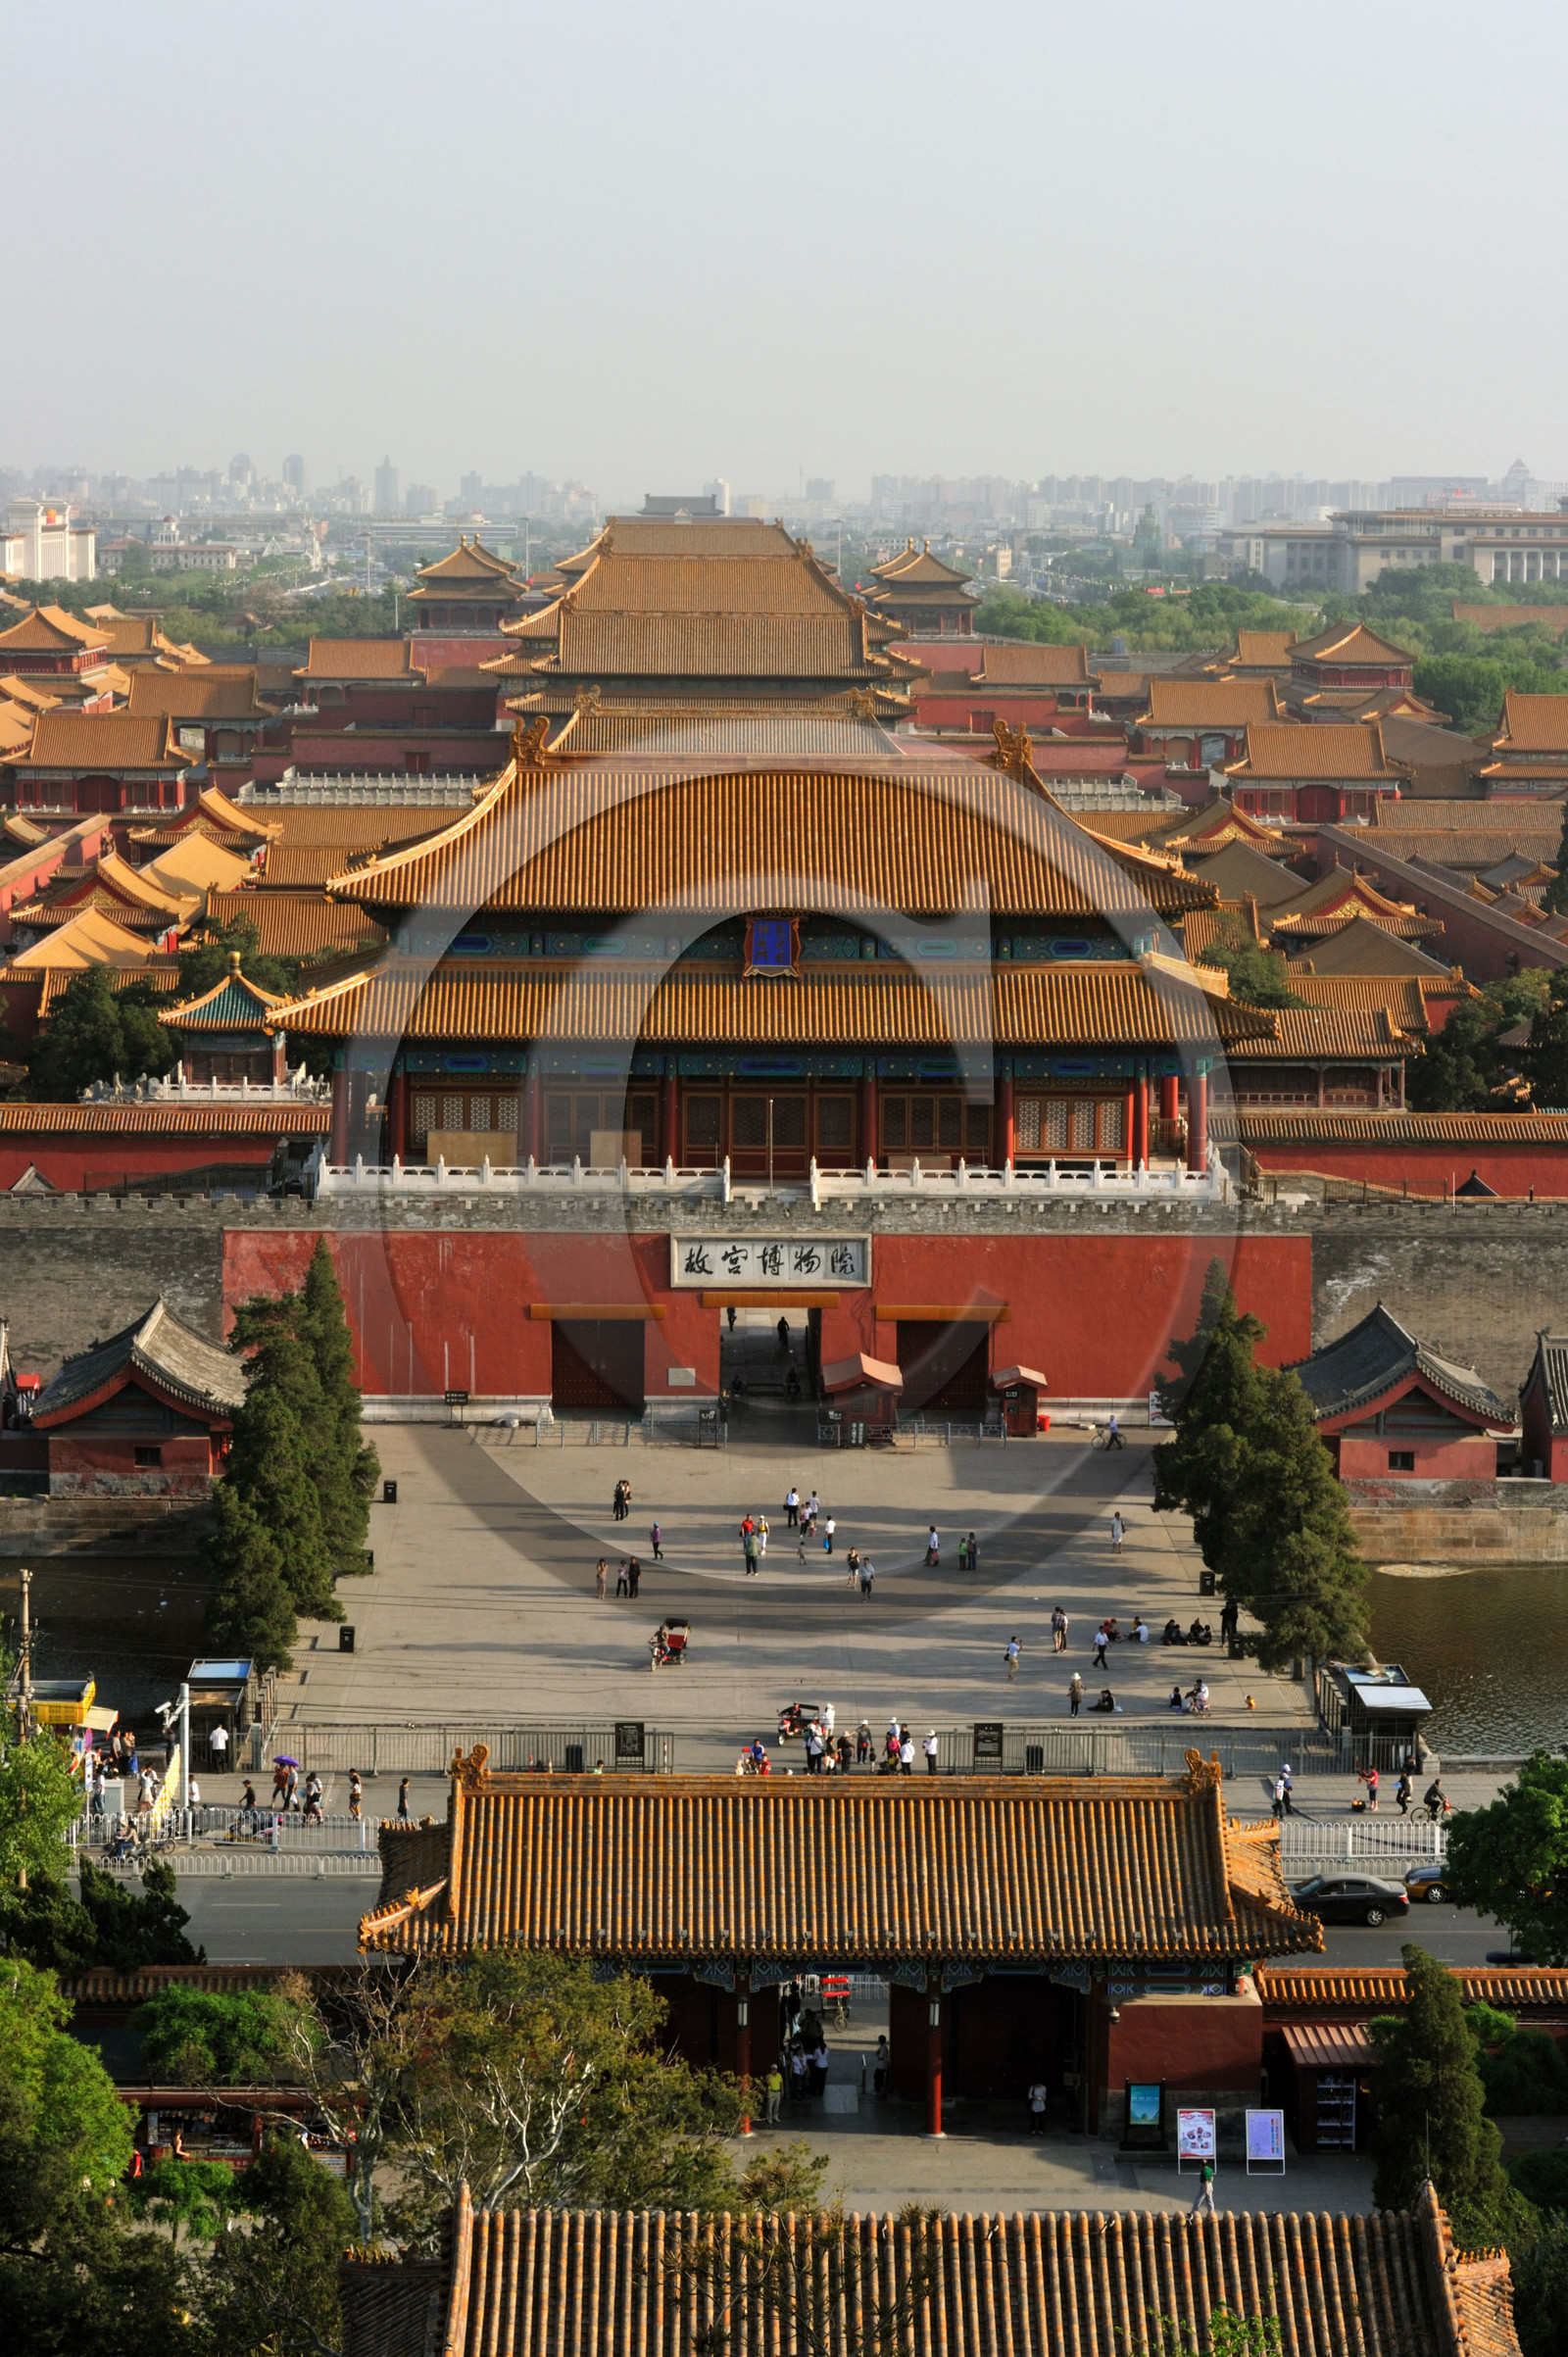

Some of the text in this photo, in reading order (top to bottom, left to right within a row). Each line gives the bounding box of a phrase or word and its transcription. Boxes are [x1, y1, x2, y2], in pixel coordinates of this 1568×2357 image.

[684, 1244, 856, 1275] 故宫博物院
